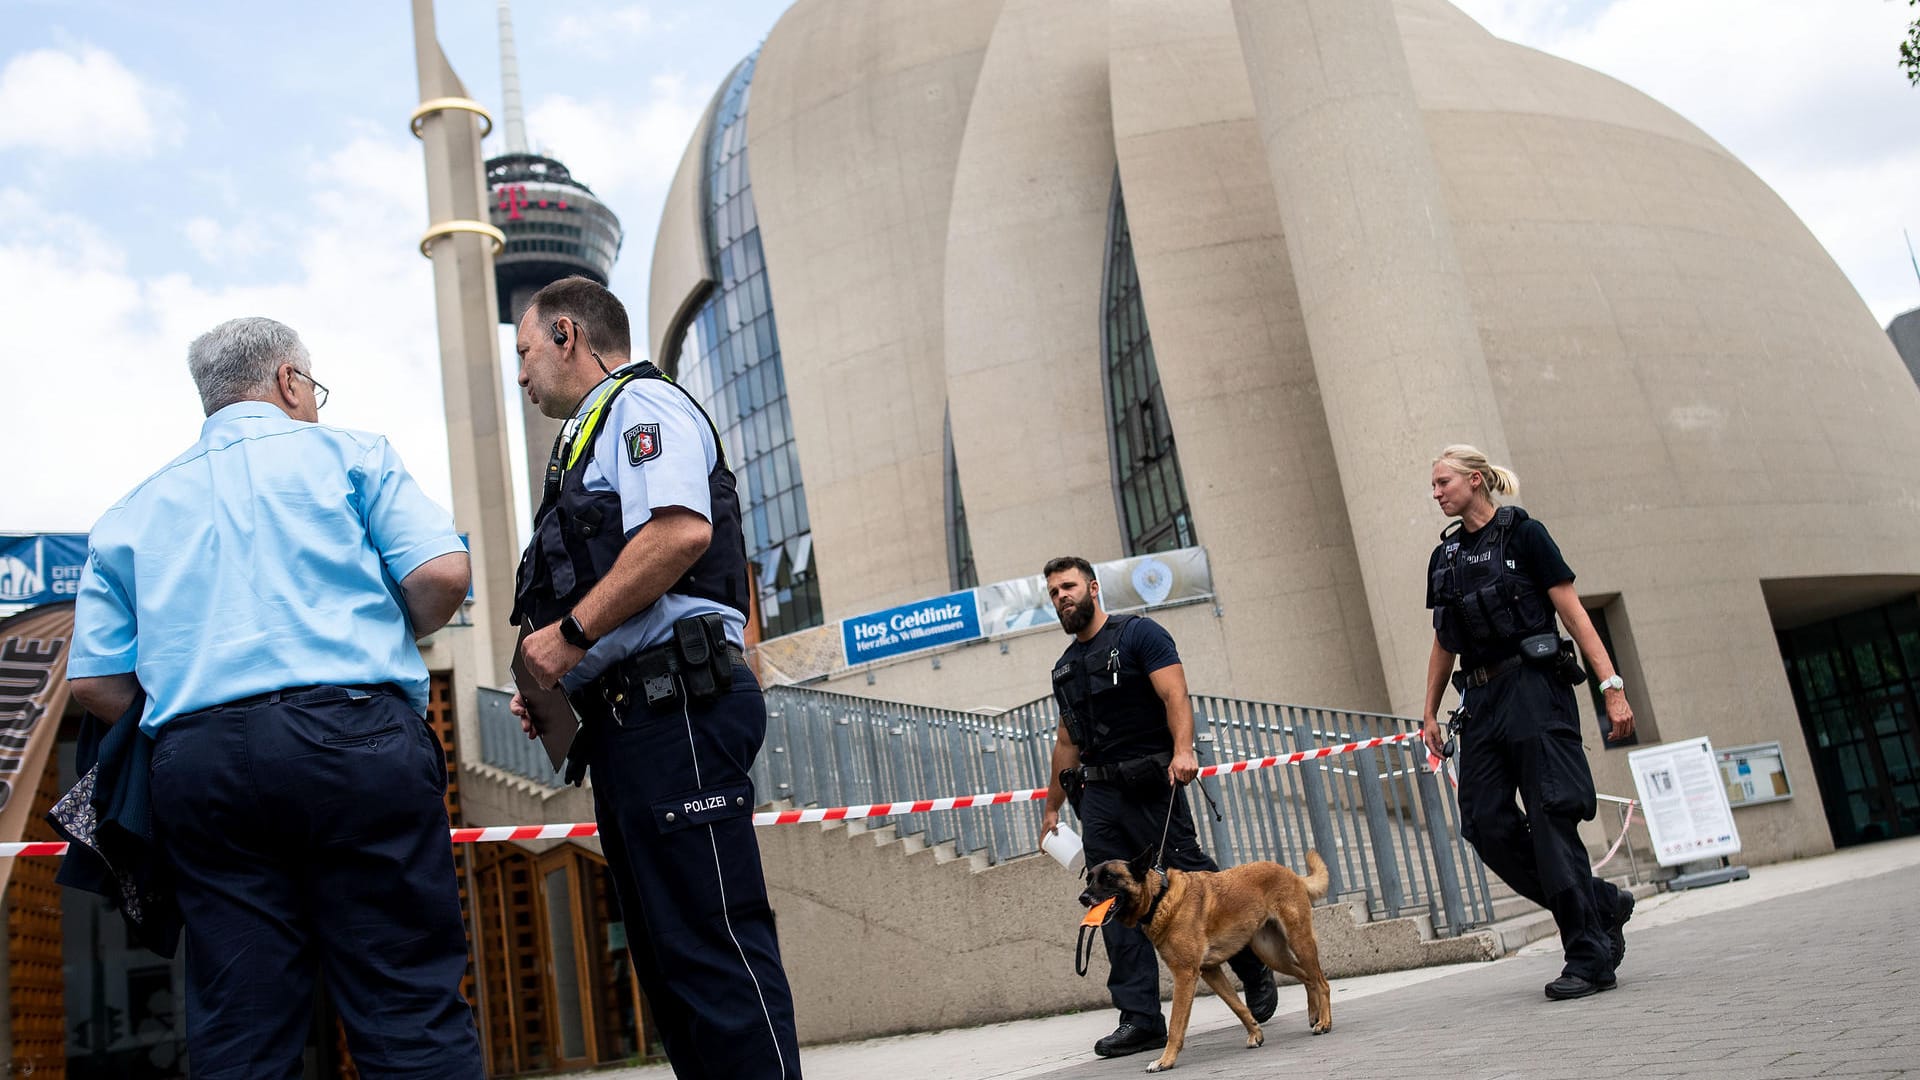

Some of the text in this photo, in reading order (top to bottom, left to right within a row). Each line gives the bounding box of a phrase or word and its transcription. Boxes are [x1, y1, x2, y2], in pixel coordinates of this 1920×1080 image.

[628, 426, 655, 440] POLIZEI
[854, 603, 962, 640] Hoş Geldiniz
[856, 620, 964, 652] Herzlich Willkommen
[684, 796, 726, 813] POLIZEI
